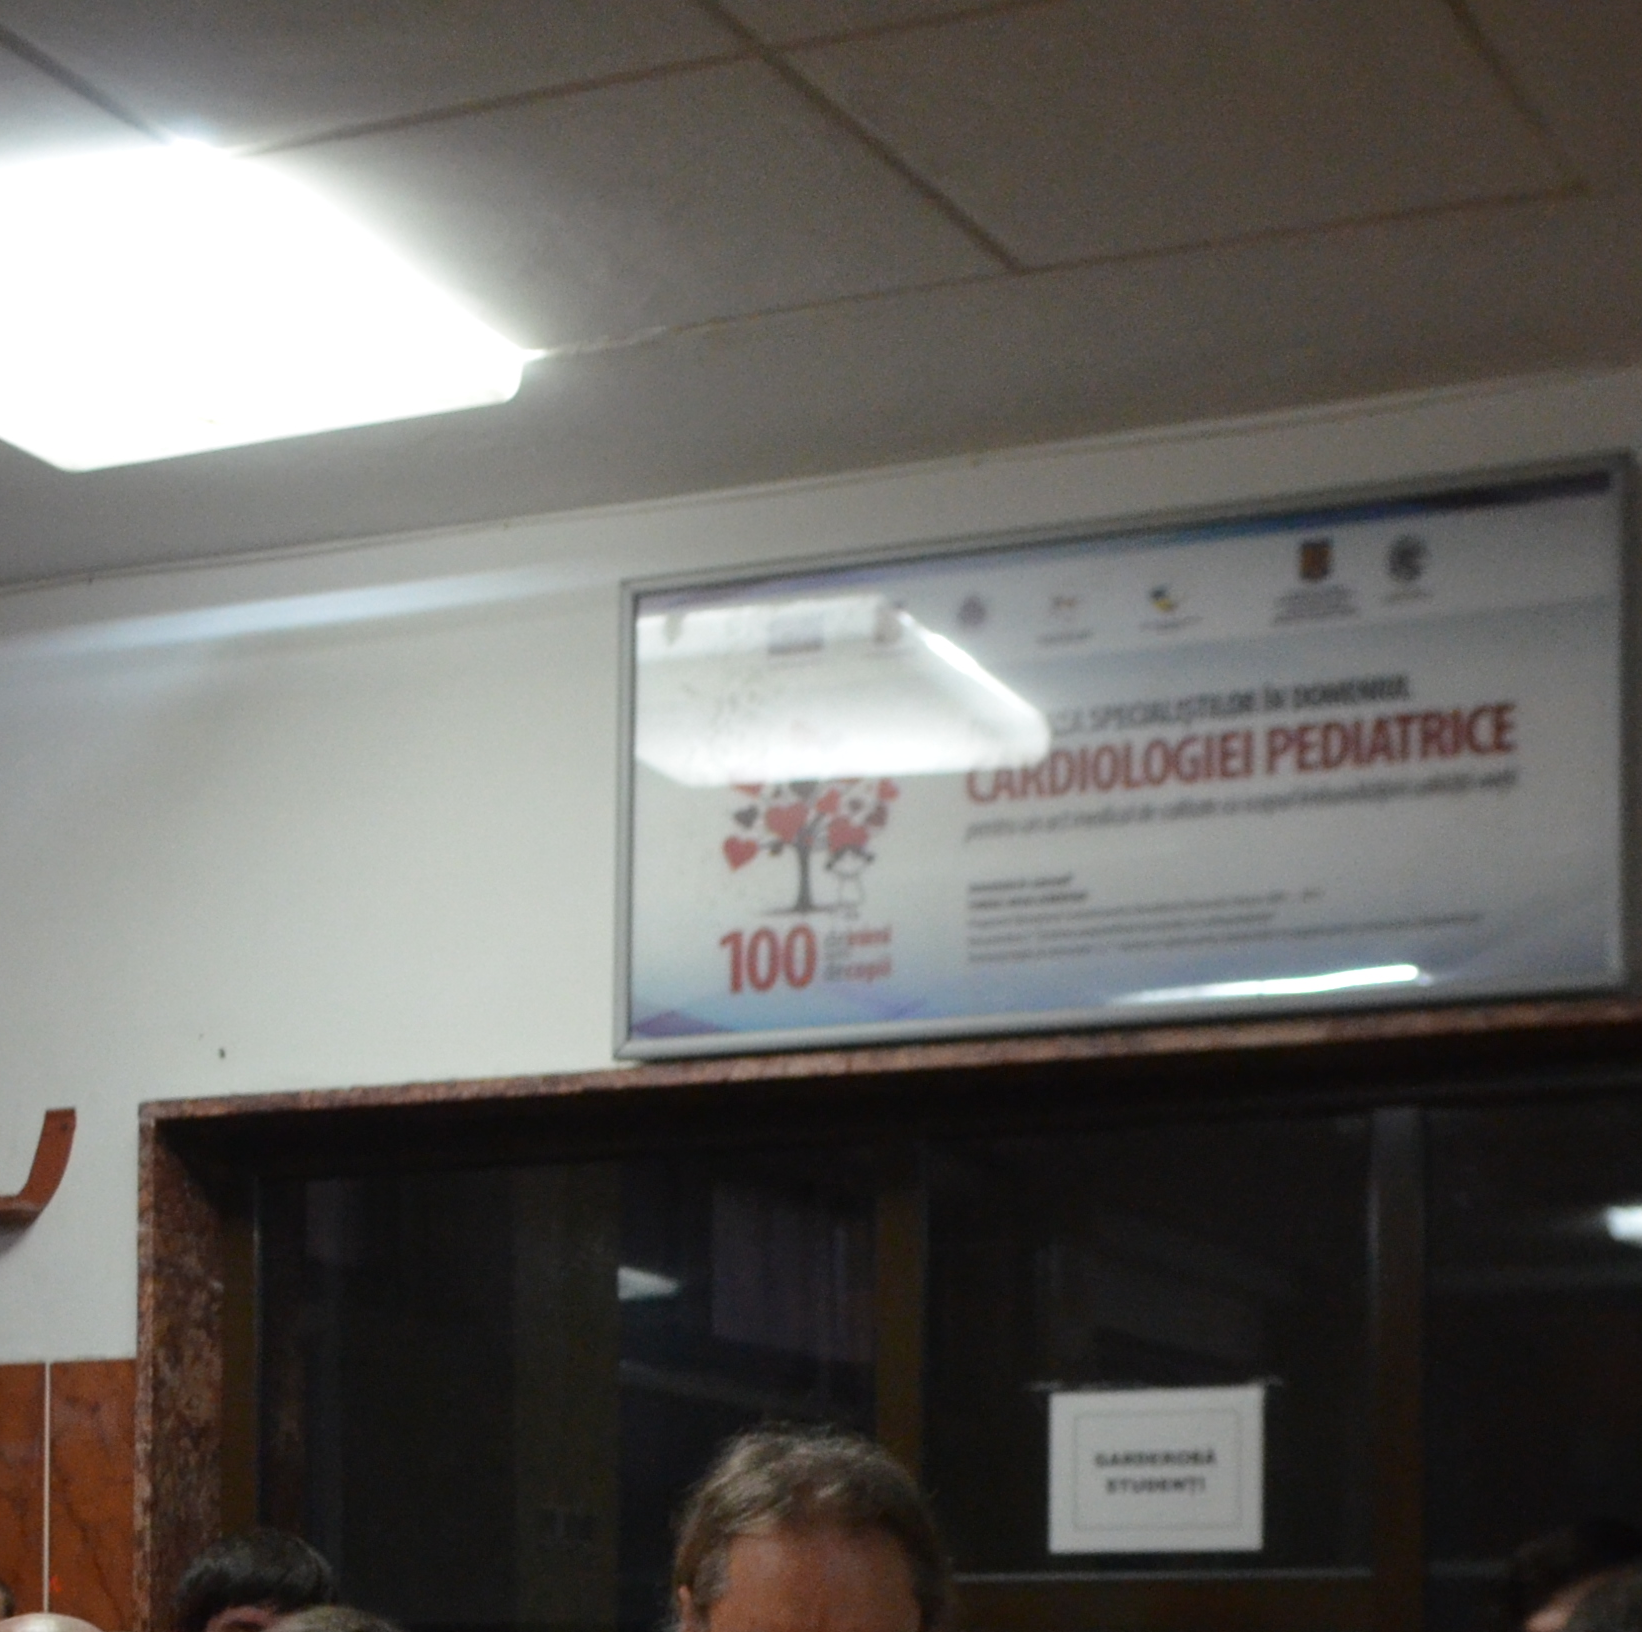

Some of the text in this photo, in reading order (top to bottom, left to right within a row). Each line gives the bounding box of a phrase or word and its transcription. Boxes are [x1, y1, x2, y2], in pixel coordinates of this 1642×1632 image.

[966, 730, 1254, 804] CARDIOLOGIEI
[1266, 702, 1517, 774] PEDIATRICE
[720, 924, 817, 994] 100
